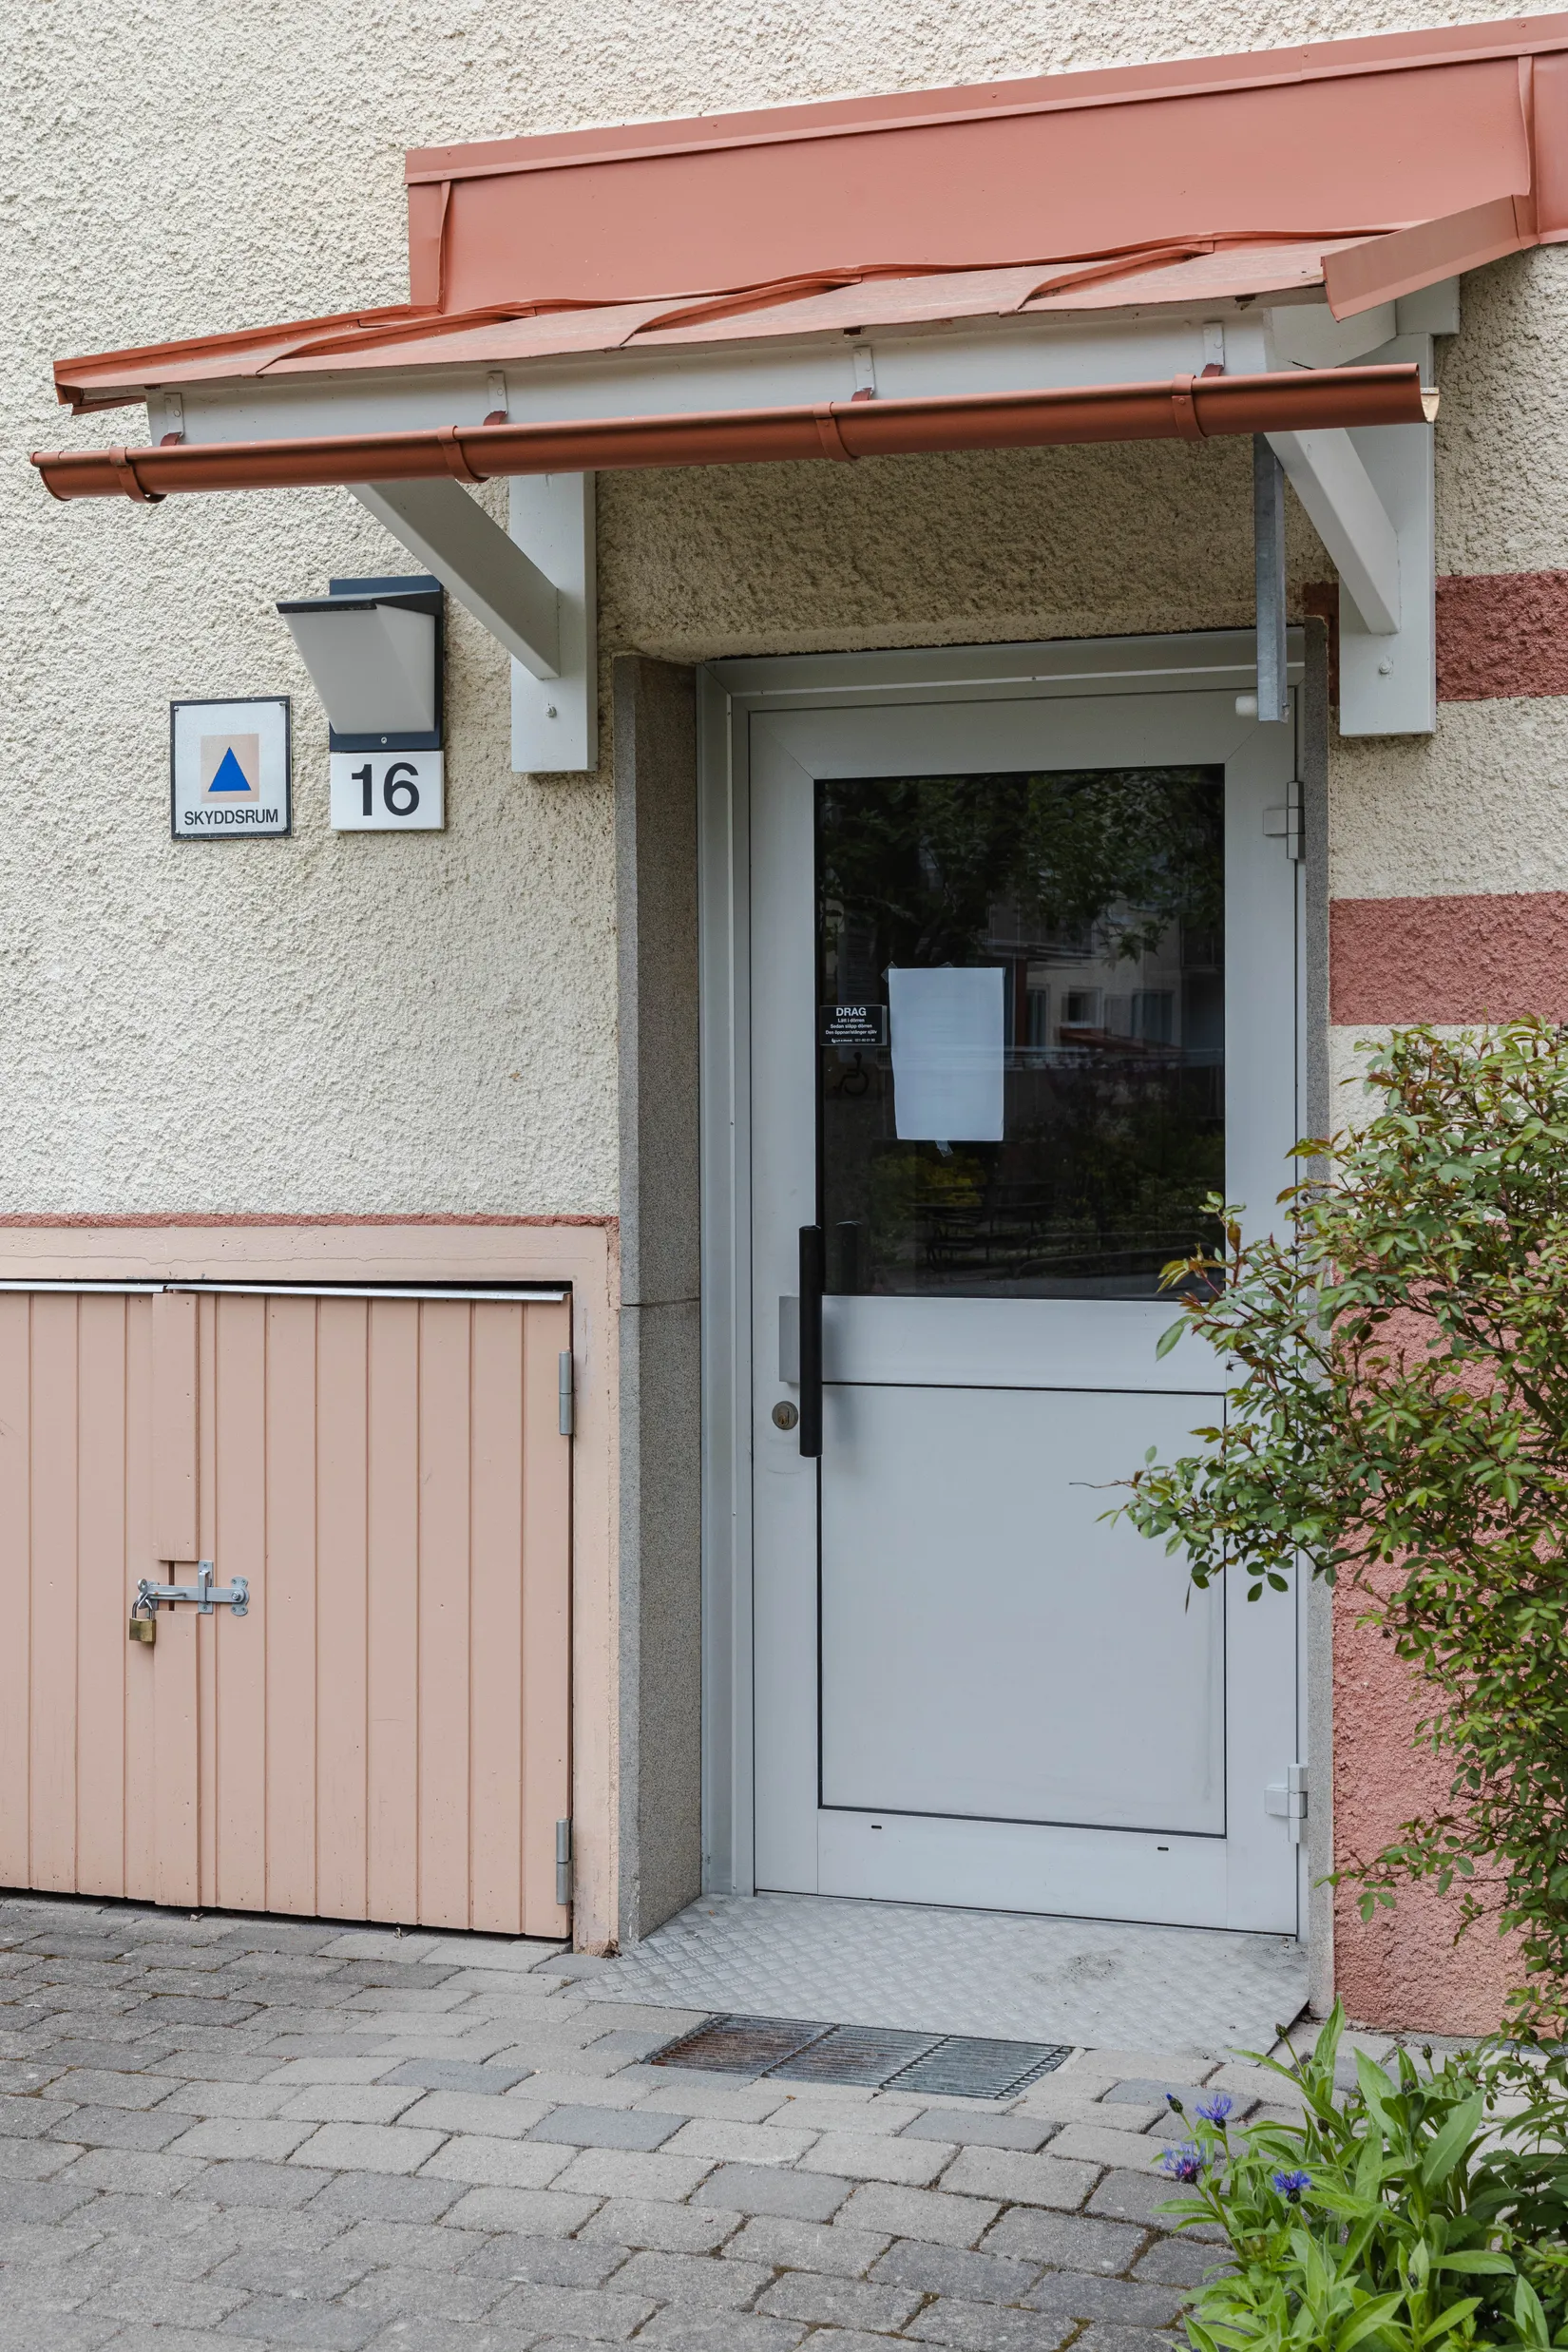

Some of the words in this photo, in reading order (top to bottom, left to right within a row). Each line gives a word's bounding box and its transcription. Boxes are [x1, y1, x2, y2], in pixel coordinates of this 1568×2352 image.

[351, 762, 420, 816] 16
[184, 809, 278, 826] SKYDDSRUM
[835, 1007, 867, 1017] DRAG
